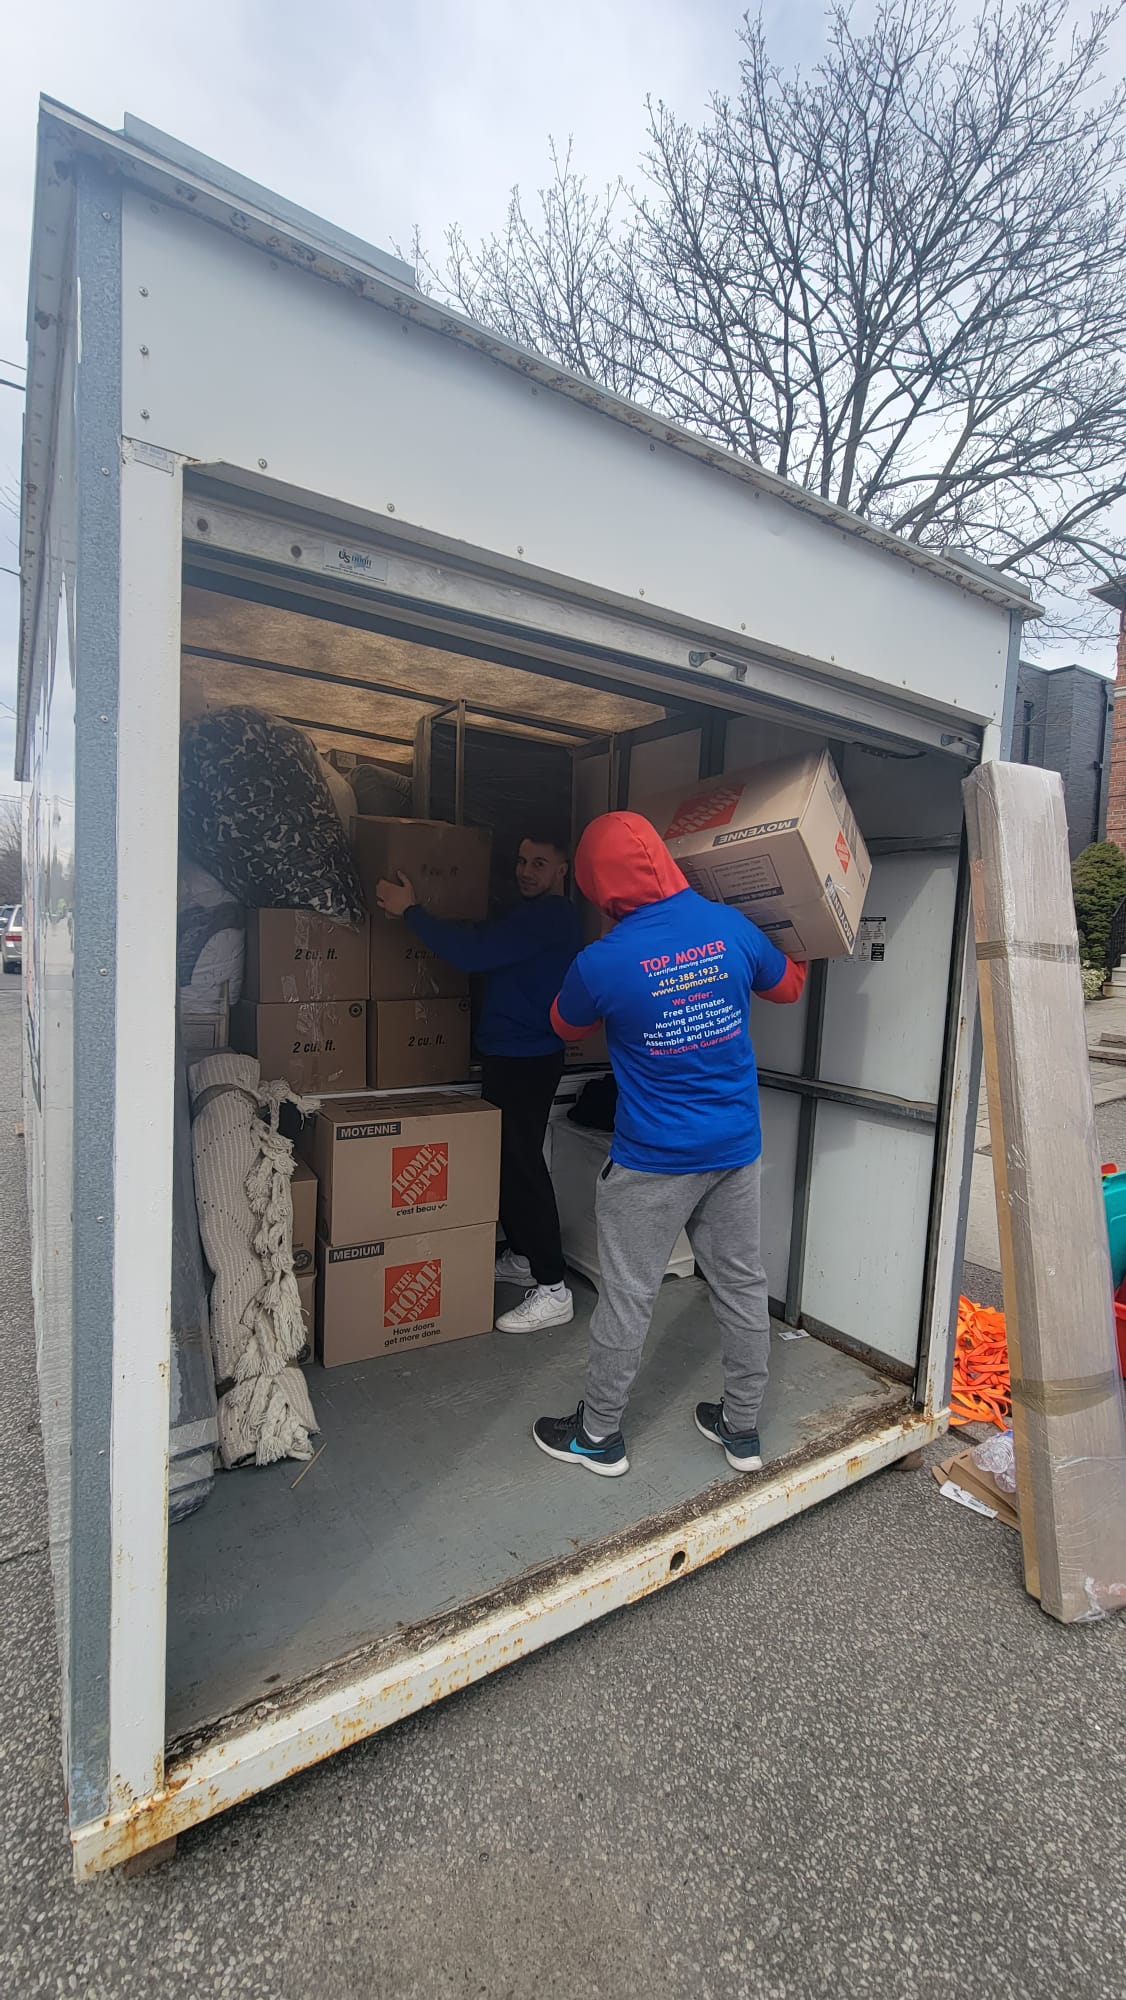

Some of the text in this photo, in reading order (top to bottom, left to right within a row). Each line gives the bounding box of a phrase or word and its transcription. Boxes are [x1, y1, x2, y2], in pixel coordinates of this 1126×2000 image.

[718, 820, 793, 844] MOYENNE
[294, 948, 302, 960] 2
[405, 948, 413, 959] 2
[639, 940, 727, 973] TOP MOVER
[653, 966, 678, 977] certified
[679, 960, 699, 970] moving
[699, 953, 724, 964] company
[651, 972, 729, 998] www.topmover.ca
[658, 965, 719, 987] 416-388-1923
[663, 997, 725, 1019] Free Estimates
[671, 991, 714, 1006] We Offer:
[655, 1004, 734, 1030] Moving and Storage
[643, 1031, 664, 1040] Pack
[665, 1028, 682, 1037] and
[683, 1020, 714, 1033] Unpack
[645, 1036, 685, 1047] Assemble
[686, 1032, 702, 1042] and
[293, 1041, 301, 1053] 2
[408, 1035, 415, 1047] 2
[649, 1043, 699, 1056] Satisfaction
[341, 1124, 397, 1138] MOYENNE
[391, 1144, 436, 1194] HOME
[401, 1150, 448, 1206] DEPOT
[396, 1204, 437, 1217] c'est beau
[333, 1244, 381, 1261] MEDIUM
[384, 1260, 441, 1326] HOME
[390, 1270, 415, 1297] THE
[406, 1281, 441, 1322] DEPOT
[392, 1321, 435, 1336] How doers
[384, 1337, 397, 1348] get
[399, 1333, 420, 1343] more
